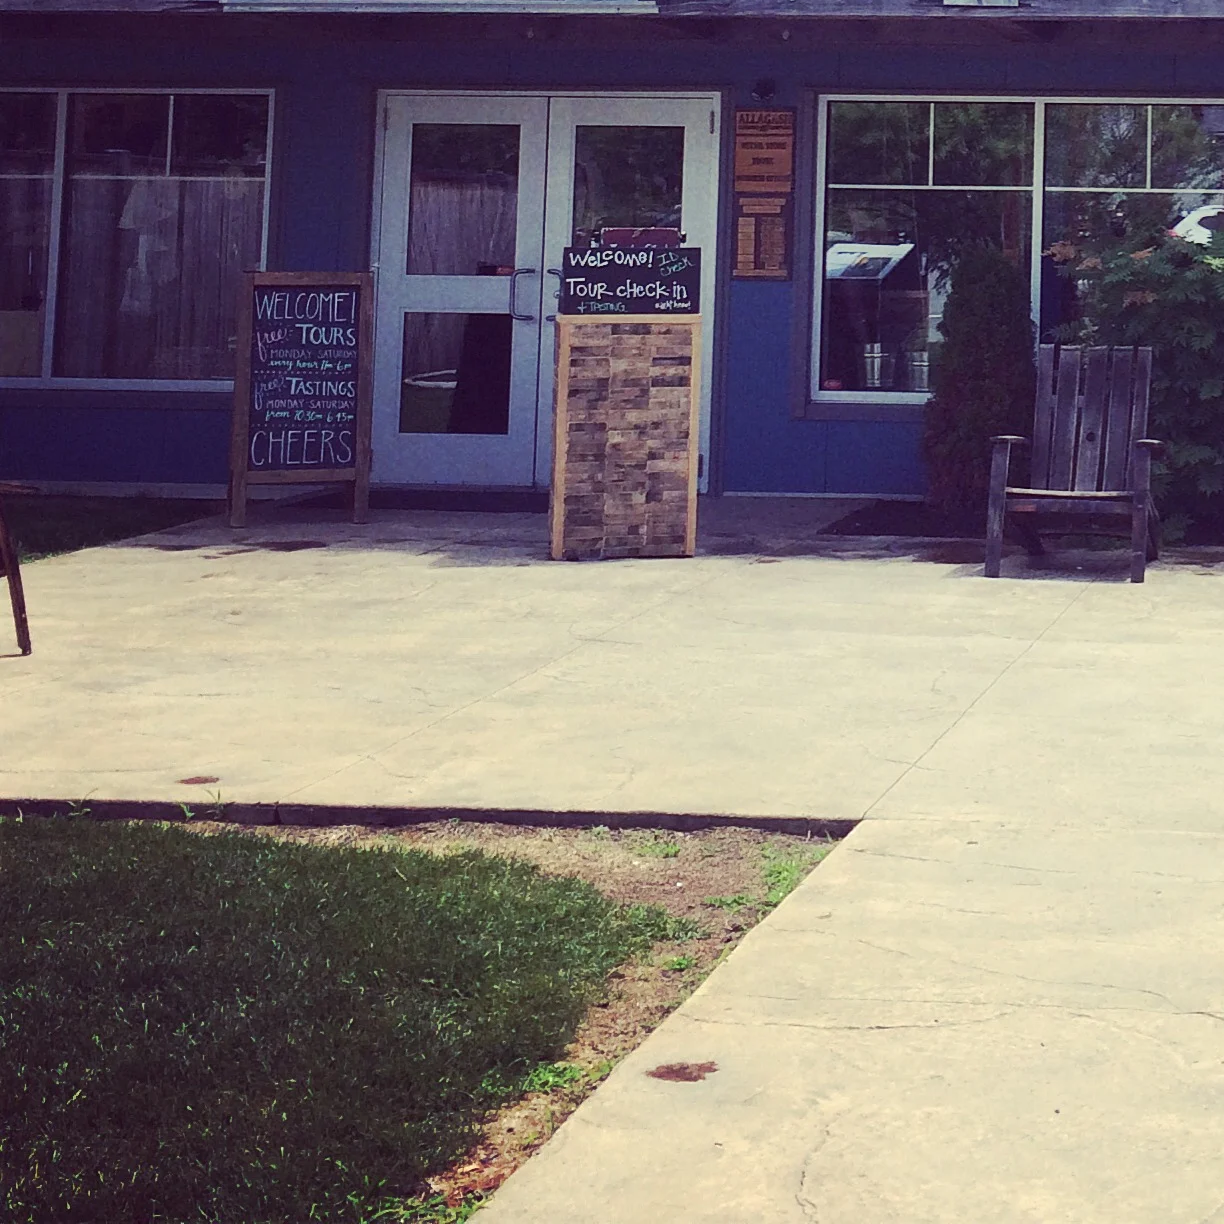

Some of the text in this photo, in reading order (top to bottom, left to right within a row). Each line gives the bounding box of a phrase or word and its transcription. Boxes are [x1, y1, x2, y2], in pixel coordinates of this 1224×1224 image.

[254, 291, 356, 324] WELCOME!
[295, 323, 356, 346] TOURS
[270, 349, 312, 359] MONDAY
[296, 360, 318, 369] hour
[286, 376, 356, 397] TASTINGS
[264, 410, 290, 422] from
[251, 429, 352, 466] CHEERS
